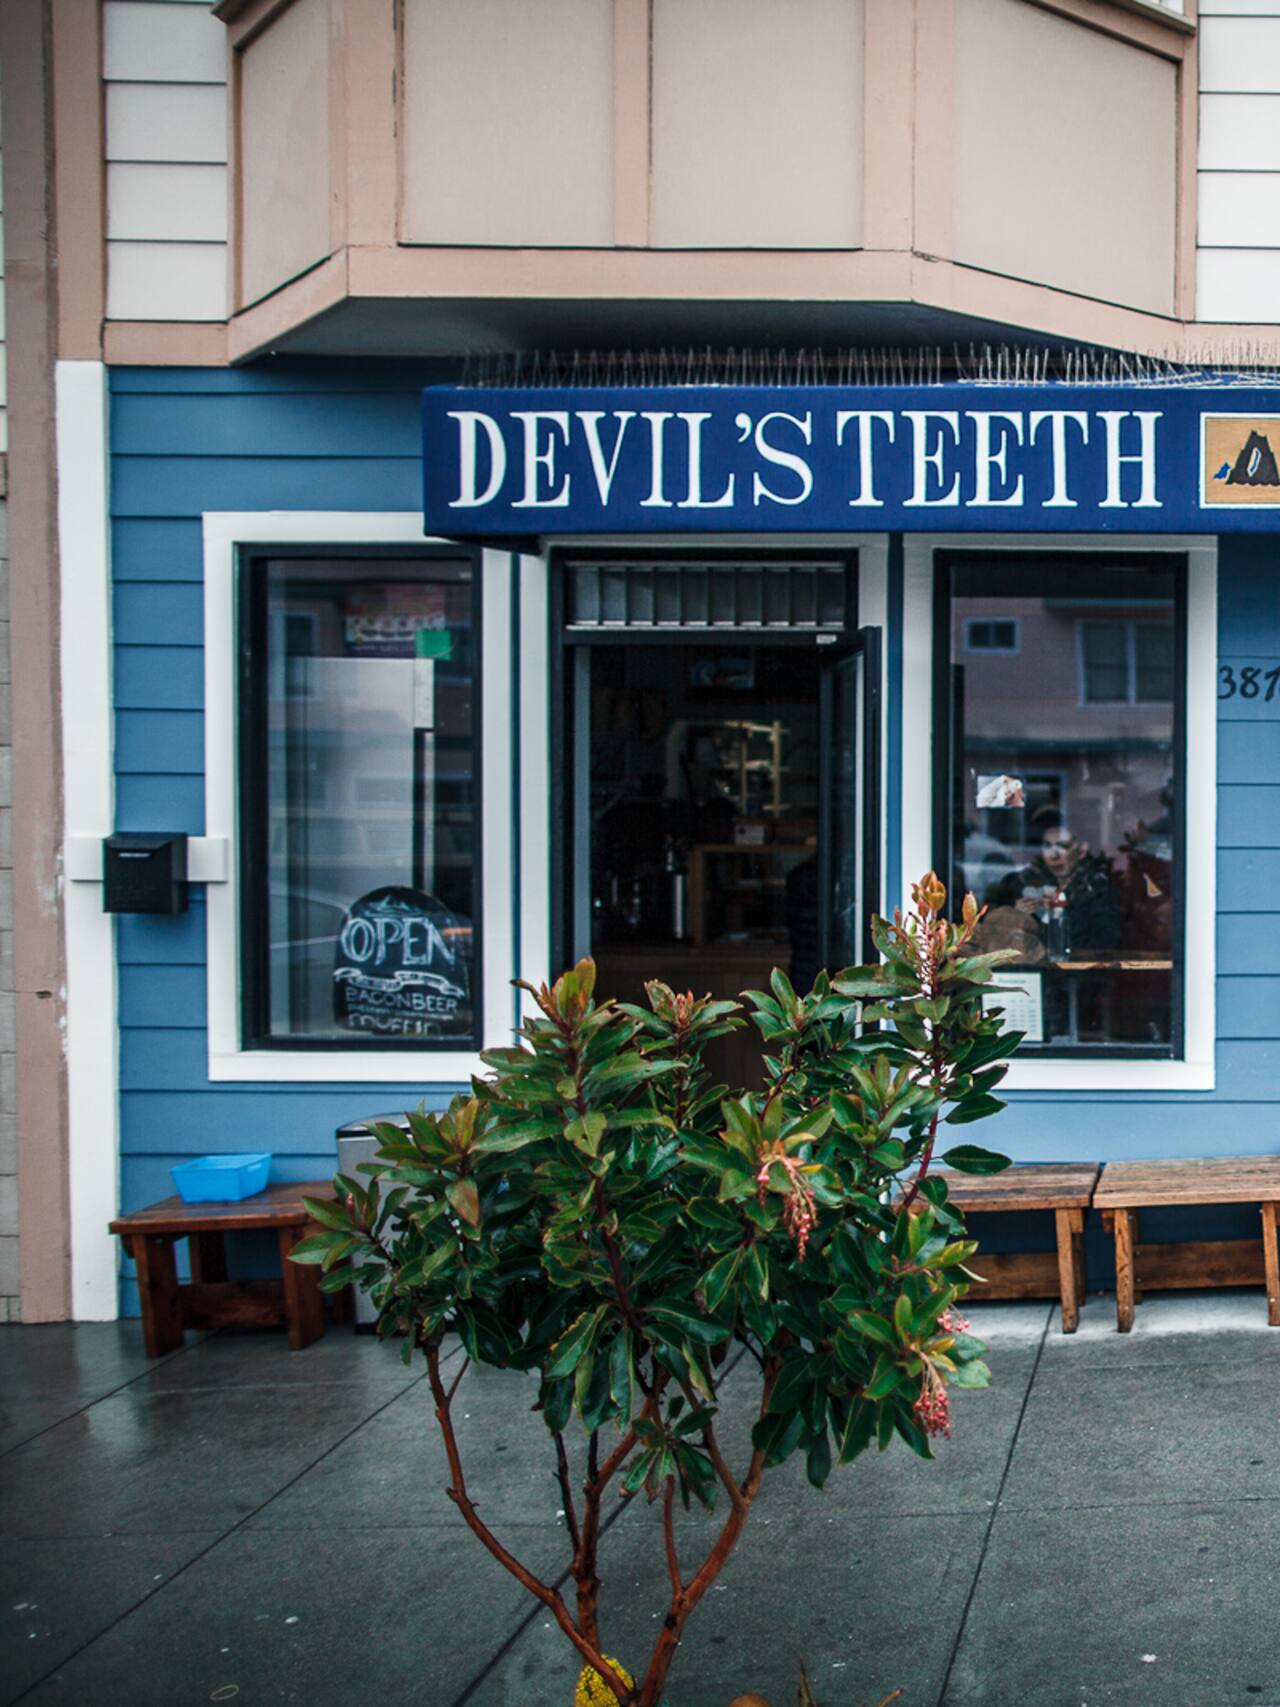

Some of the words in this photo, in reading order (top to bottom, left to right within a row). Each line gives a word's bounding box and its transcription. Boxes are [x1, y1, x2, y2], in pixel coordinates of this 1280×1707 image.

[446, 409, 813, 508] DEVIL'S
[835, 409, 1163, 508] TEETH
[340, 917, 455, 966] OPEN
